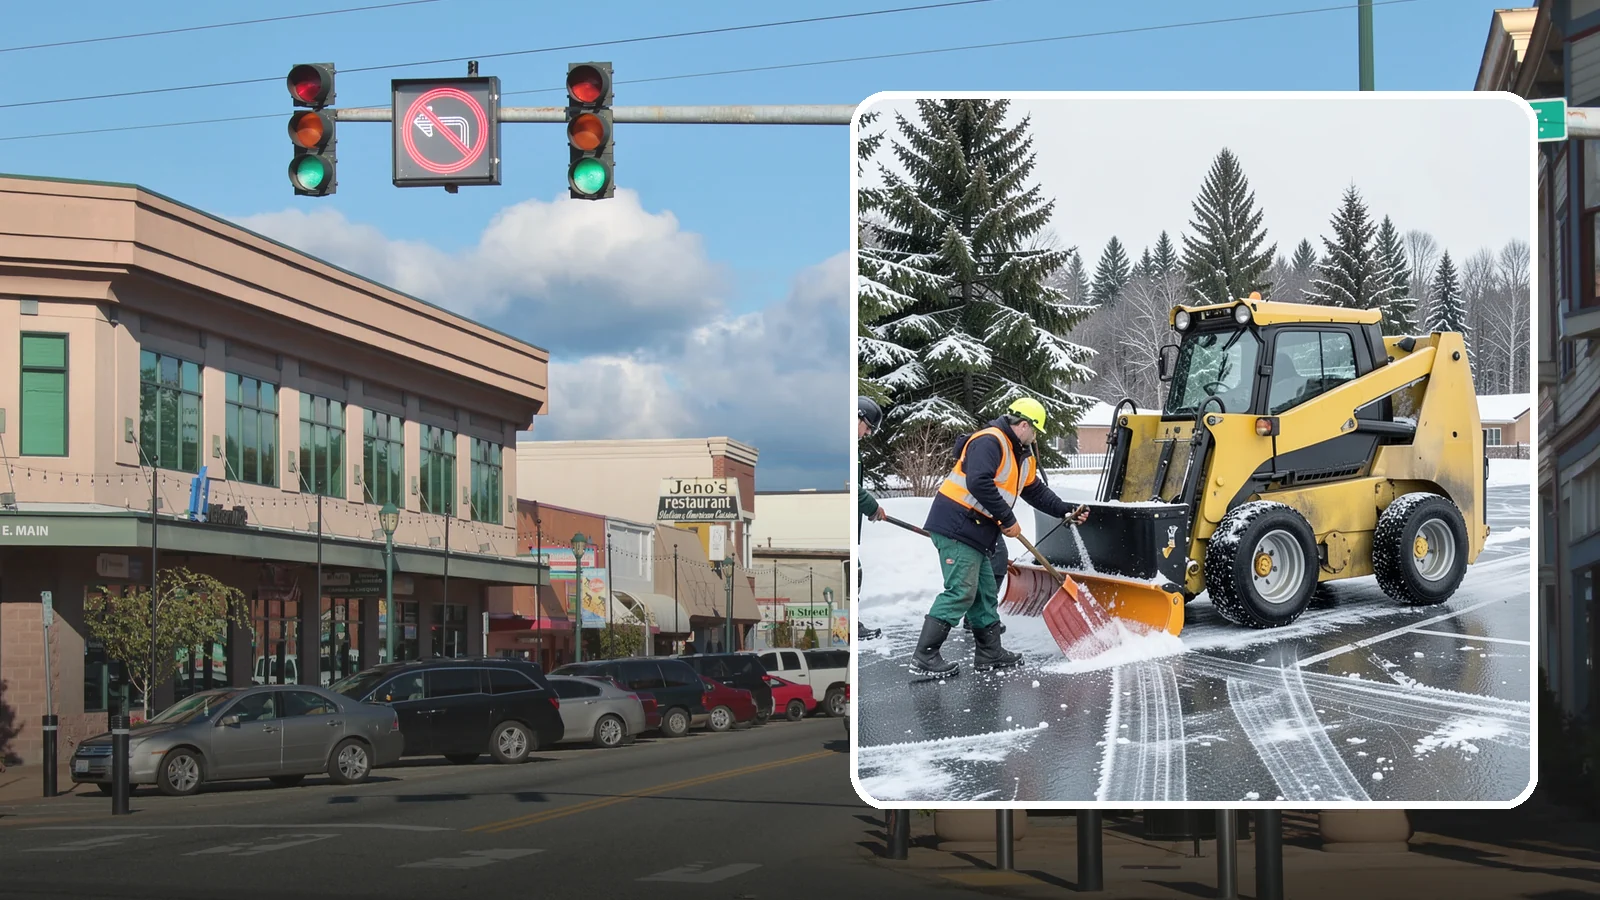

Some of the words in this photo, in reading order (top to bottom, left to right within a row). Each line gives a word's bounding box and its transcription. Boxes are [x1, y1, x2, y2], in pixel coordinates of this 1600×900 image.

[670, 480, 728, 494] Jeno's
[665, 496, 731, 509] restaurant
[658, 510, 682, 520] Italian
[686, 510, 714, 519] American
[714, 509, 738, 519] Cuisine
[2, 525, 13, 536] E.
[15, 525, 49, 536] MAIN
[797, 607, 828, 616] Street
[791, 619, 823, 627] lass
